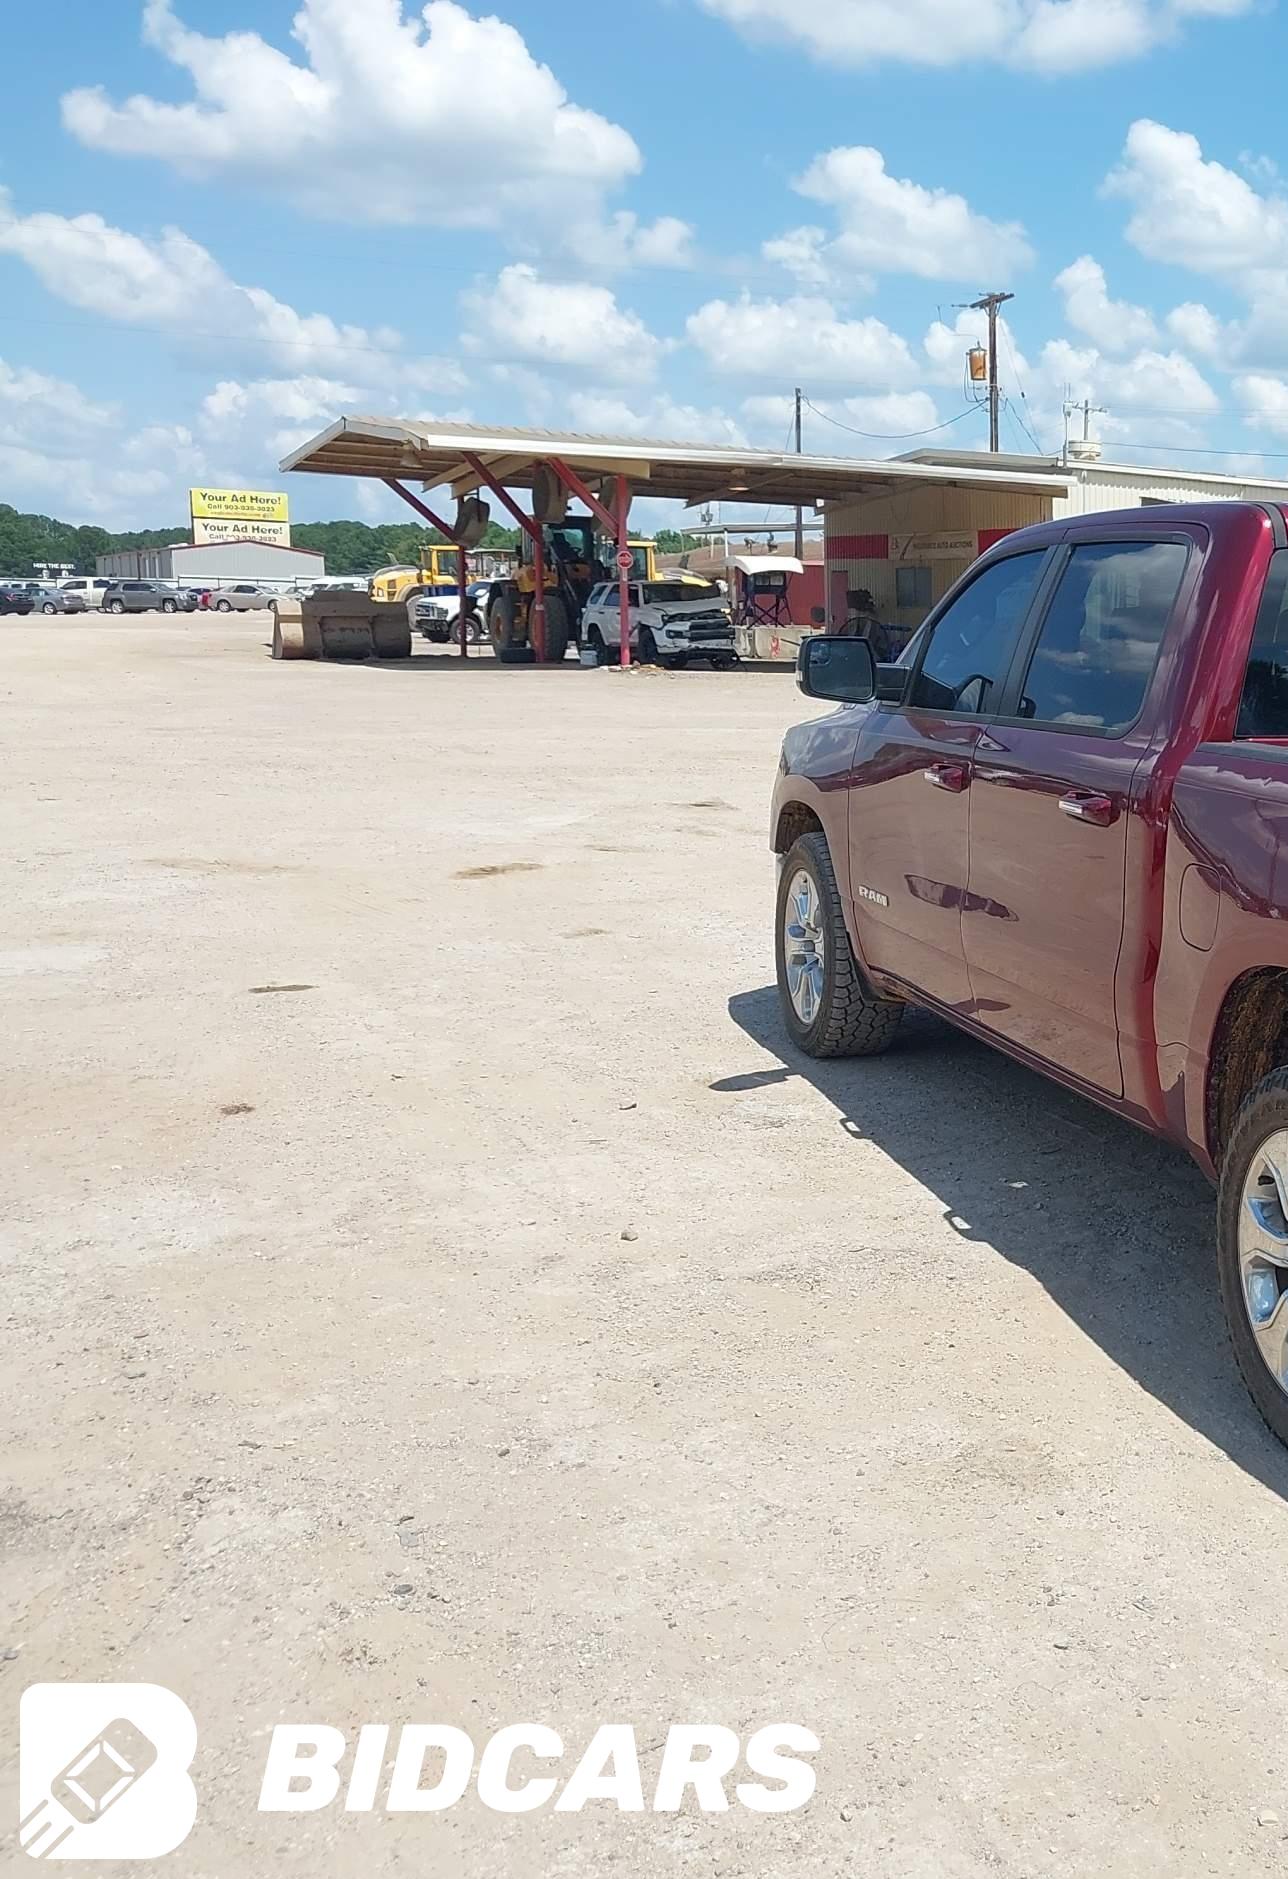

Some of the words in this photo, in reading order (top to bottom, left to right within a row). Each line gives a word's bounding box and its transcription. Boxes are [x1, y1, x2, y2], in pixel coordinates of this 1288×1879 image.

[200, 492, 227, 502] Your
[231, 494, 246, 503] Ad
[250, 495, 281, 505] Here!
[202, 523, 229, 532] Your
[232, 524, 248, 533] Ad
[252, 526, 283, 535] Here!
[858, 885, 888, 907] RAM
